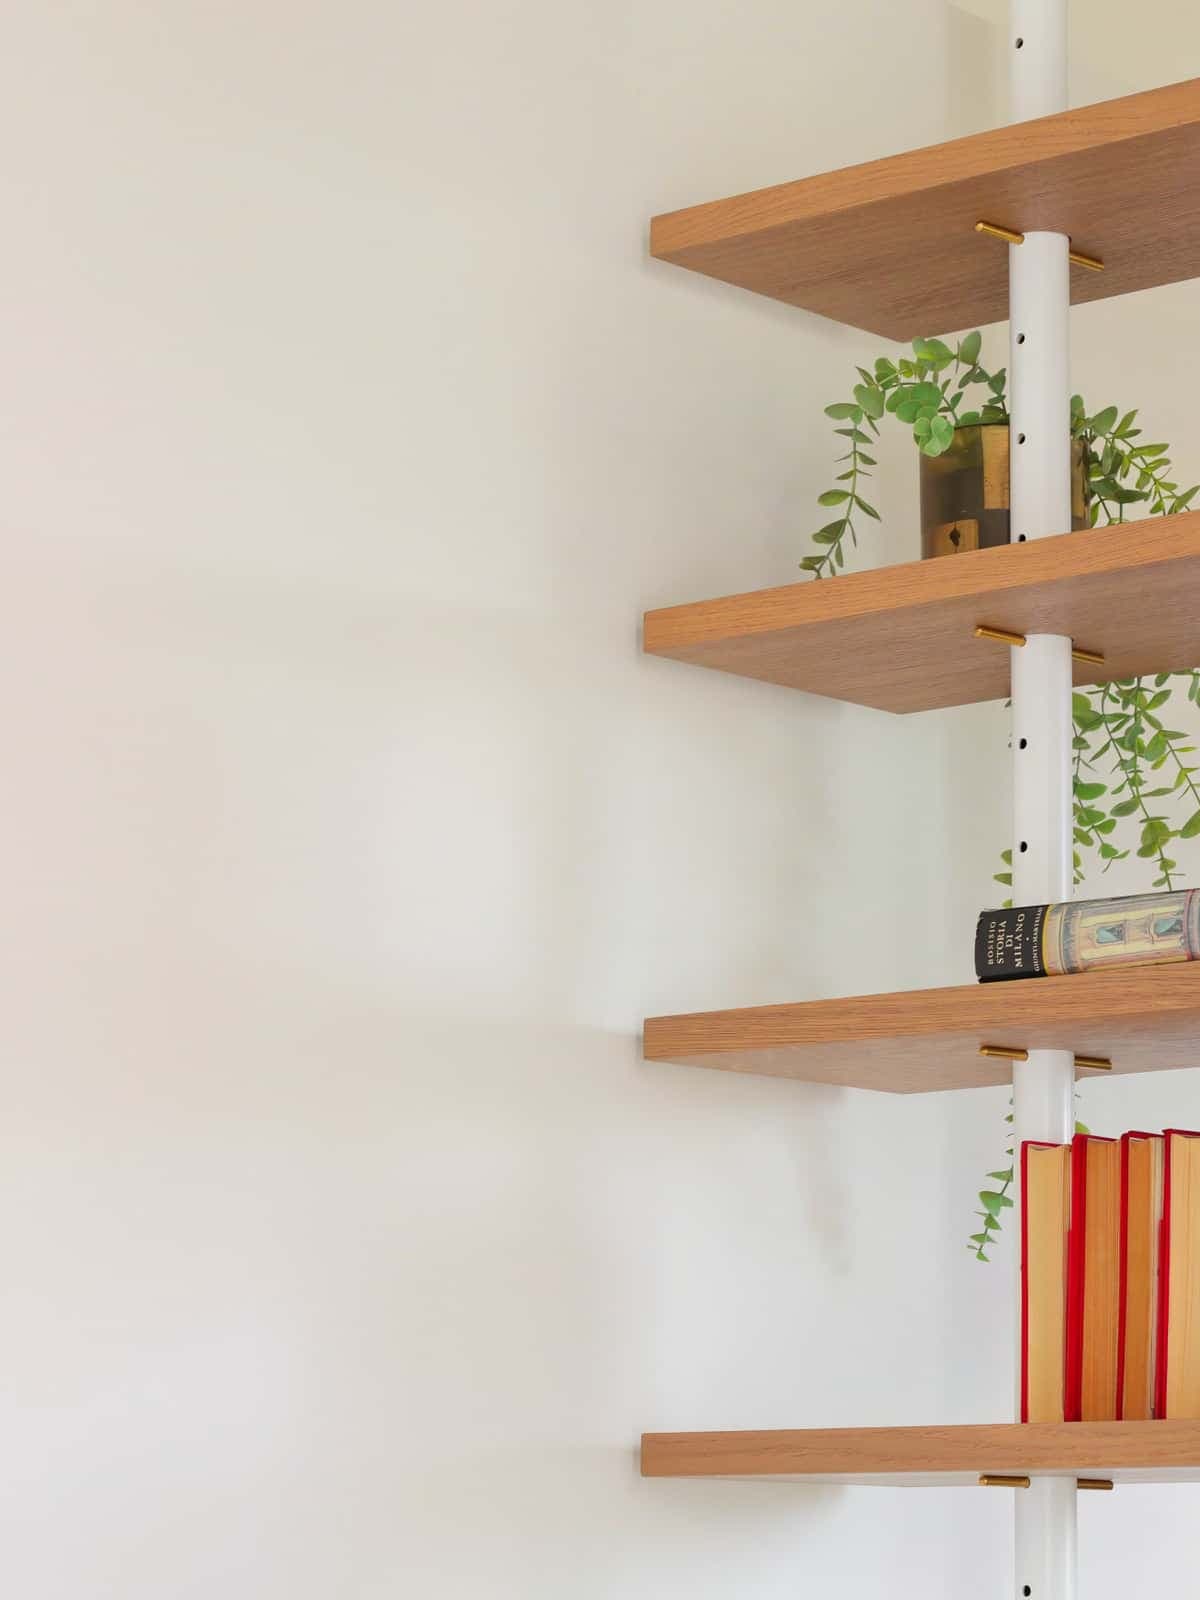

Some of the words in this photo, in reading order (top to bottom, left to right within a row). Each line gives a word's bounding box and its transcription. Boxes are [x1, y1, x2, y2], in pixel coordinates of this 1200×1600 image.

[987, 921, 997, 965] BOSISIO
[996, 920, 1007, 964] STORIA
[1005, 934, 1014, 948] DI
[1014, 913, 1025, 968] MILANO
